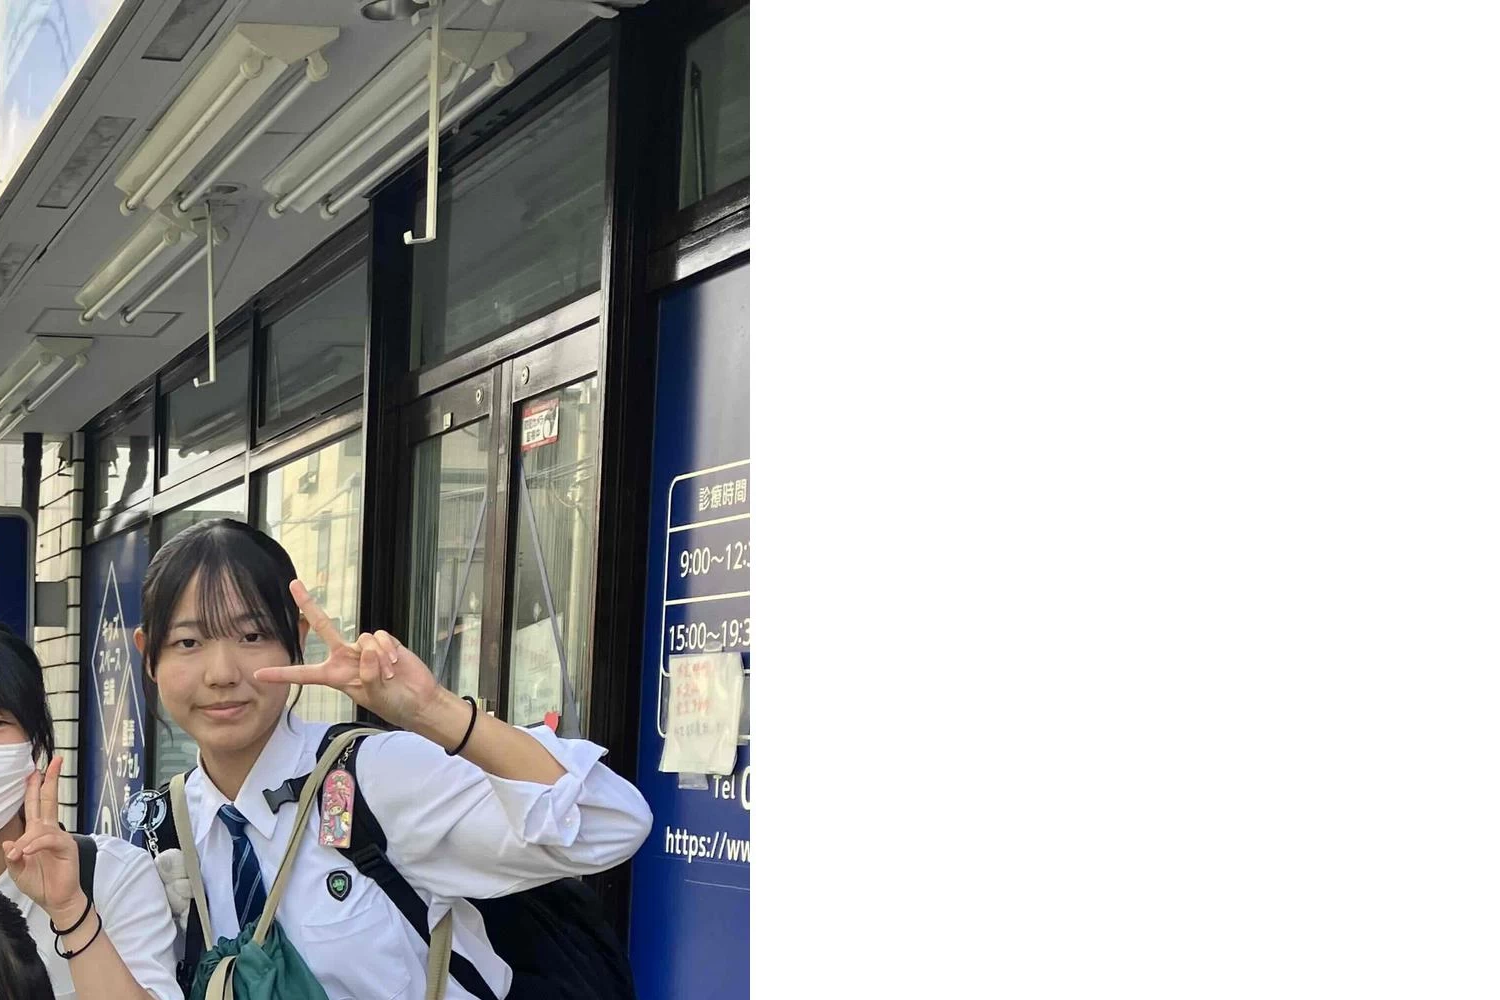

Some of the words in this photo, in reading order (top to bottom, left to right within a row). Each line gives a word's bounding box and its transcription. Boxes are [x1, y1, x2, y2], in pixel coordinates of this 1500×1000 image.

[698, 479, 747, 511] 診療時間
[713, 774, 735, 799] Tel
